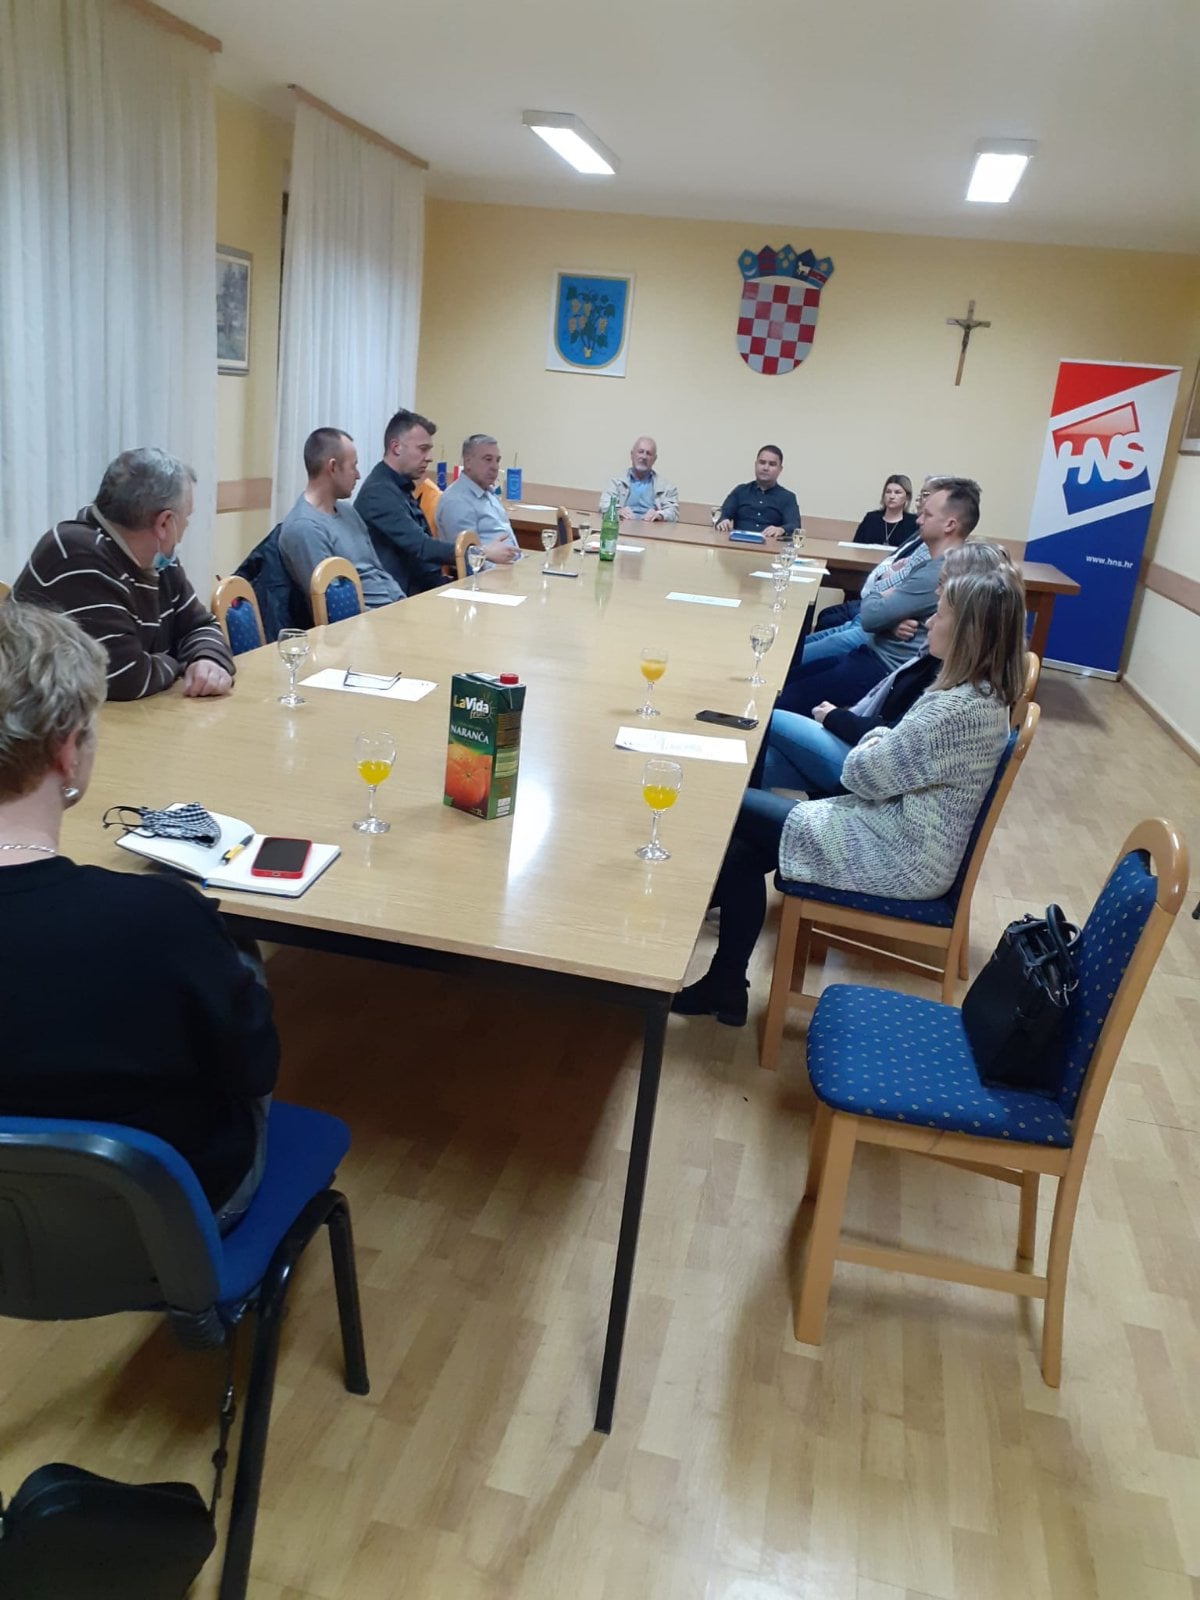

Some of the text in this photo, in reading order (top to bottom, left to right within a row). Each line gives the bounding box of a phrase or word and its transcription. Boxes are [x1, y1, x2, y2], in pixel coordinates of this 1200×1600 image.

[1056, 432, 1147, 485] HNS
[1086, 555, 1134, 569] www.hns.hr
[453, 694, 489, 714] LaVida
[451, 725, 489, 744] NARANČA
